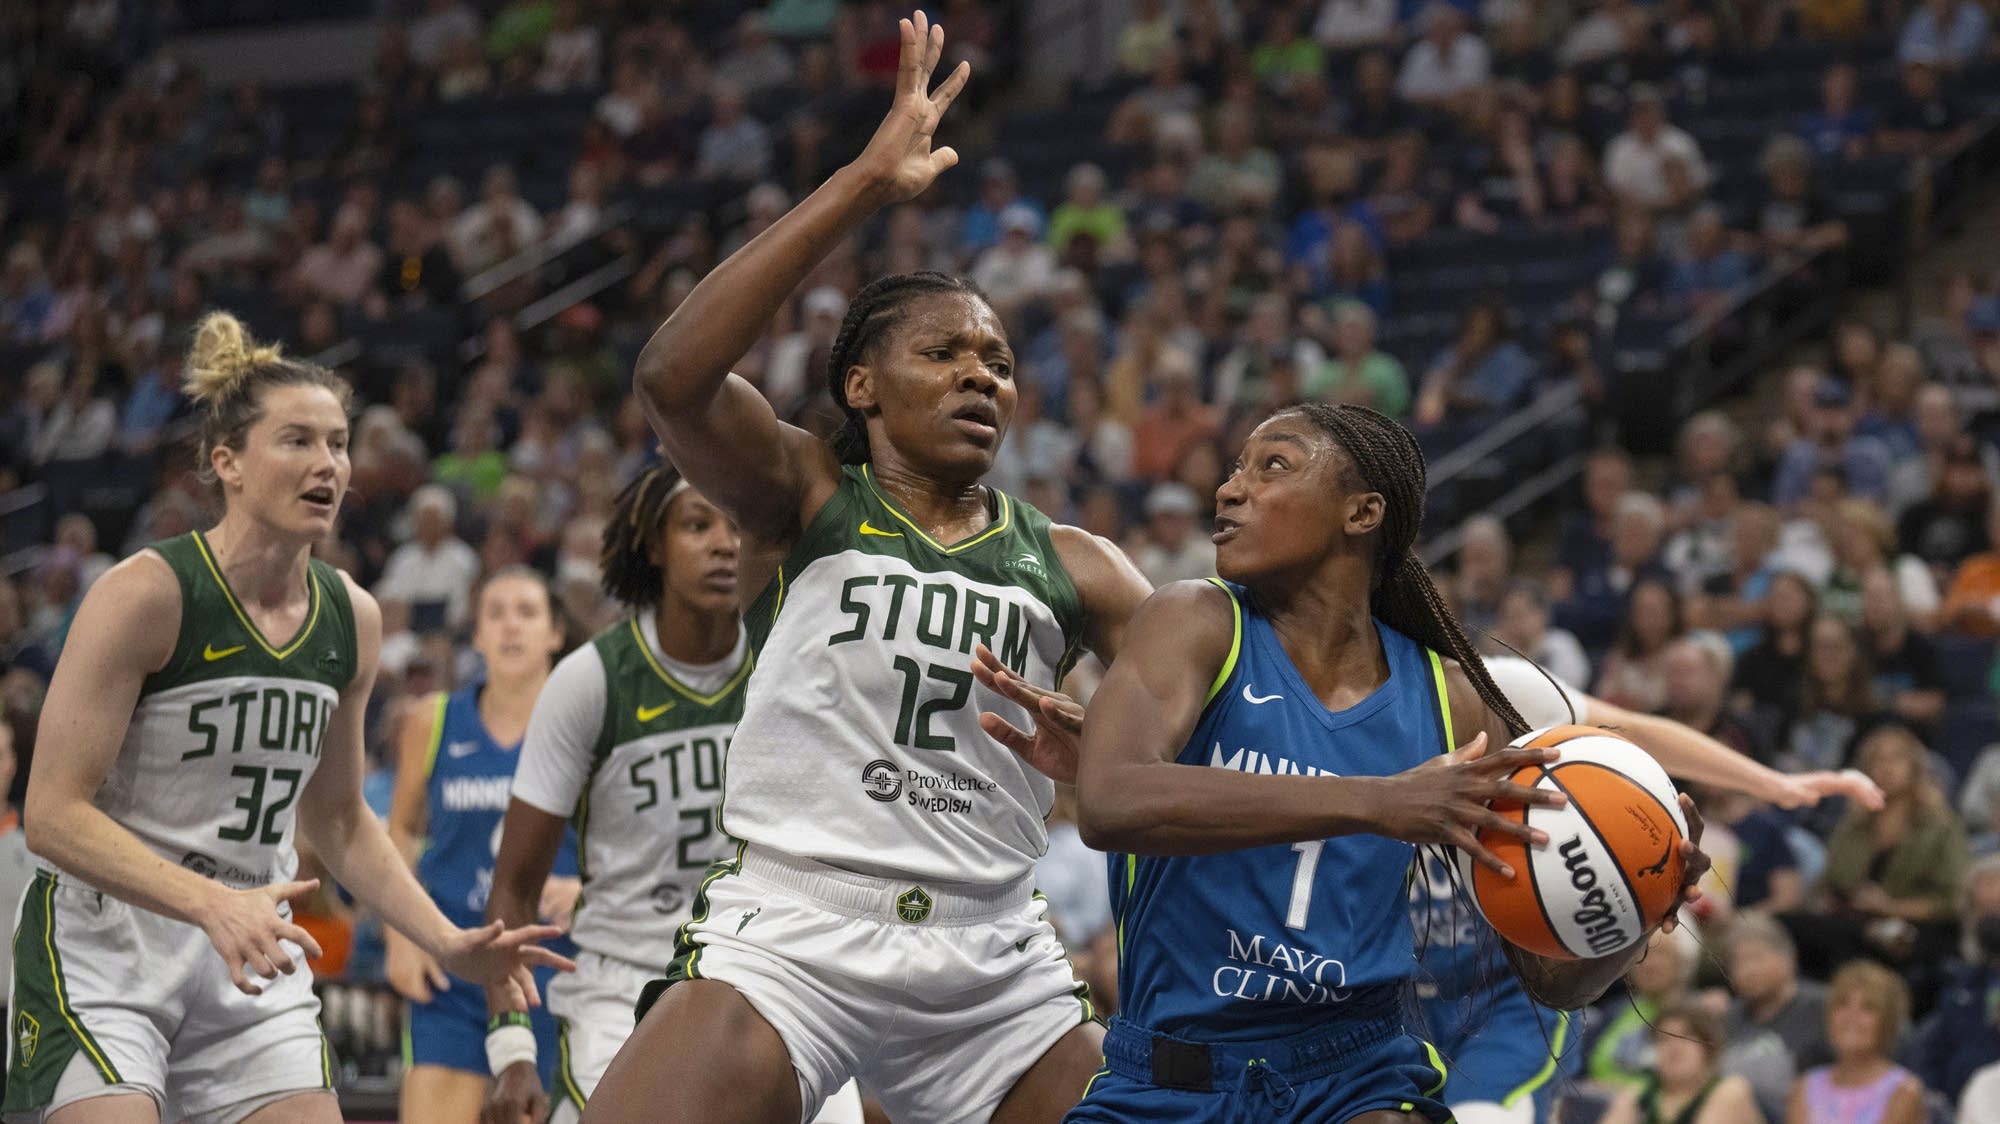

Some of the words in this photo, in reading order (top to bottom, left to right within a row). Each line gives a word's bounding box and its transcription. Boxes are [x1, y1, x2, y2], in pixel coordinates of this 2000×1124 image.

[1005, 560, 1048, 581] SYMETRA
[828, 574, 1031, 678] STORM
[893, 655, 974, 752] 12
[218, 765, 302, 845] 32
[629, 737, 731, 813] STO
[907, 770, 997, 793] Providence
[908, 791, 972, 814] SWEDISH
[1285, 839, 1326, 931] 1
[1558, 833, 1629, 955] Wilson
[1226, 929, 1346, 988] MAYO
